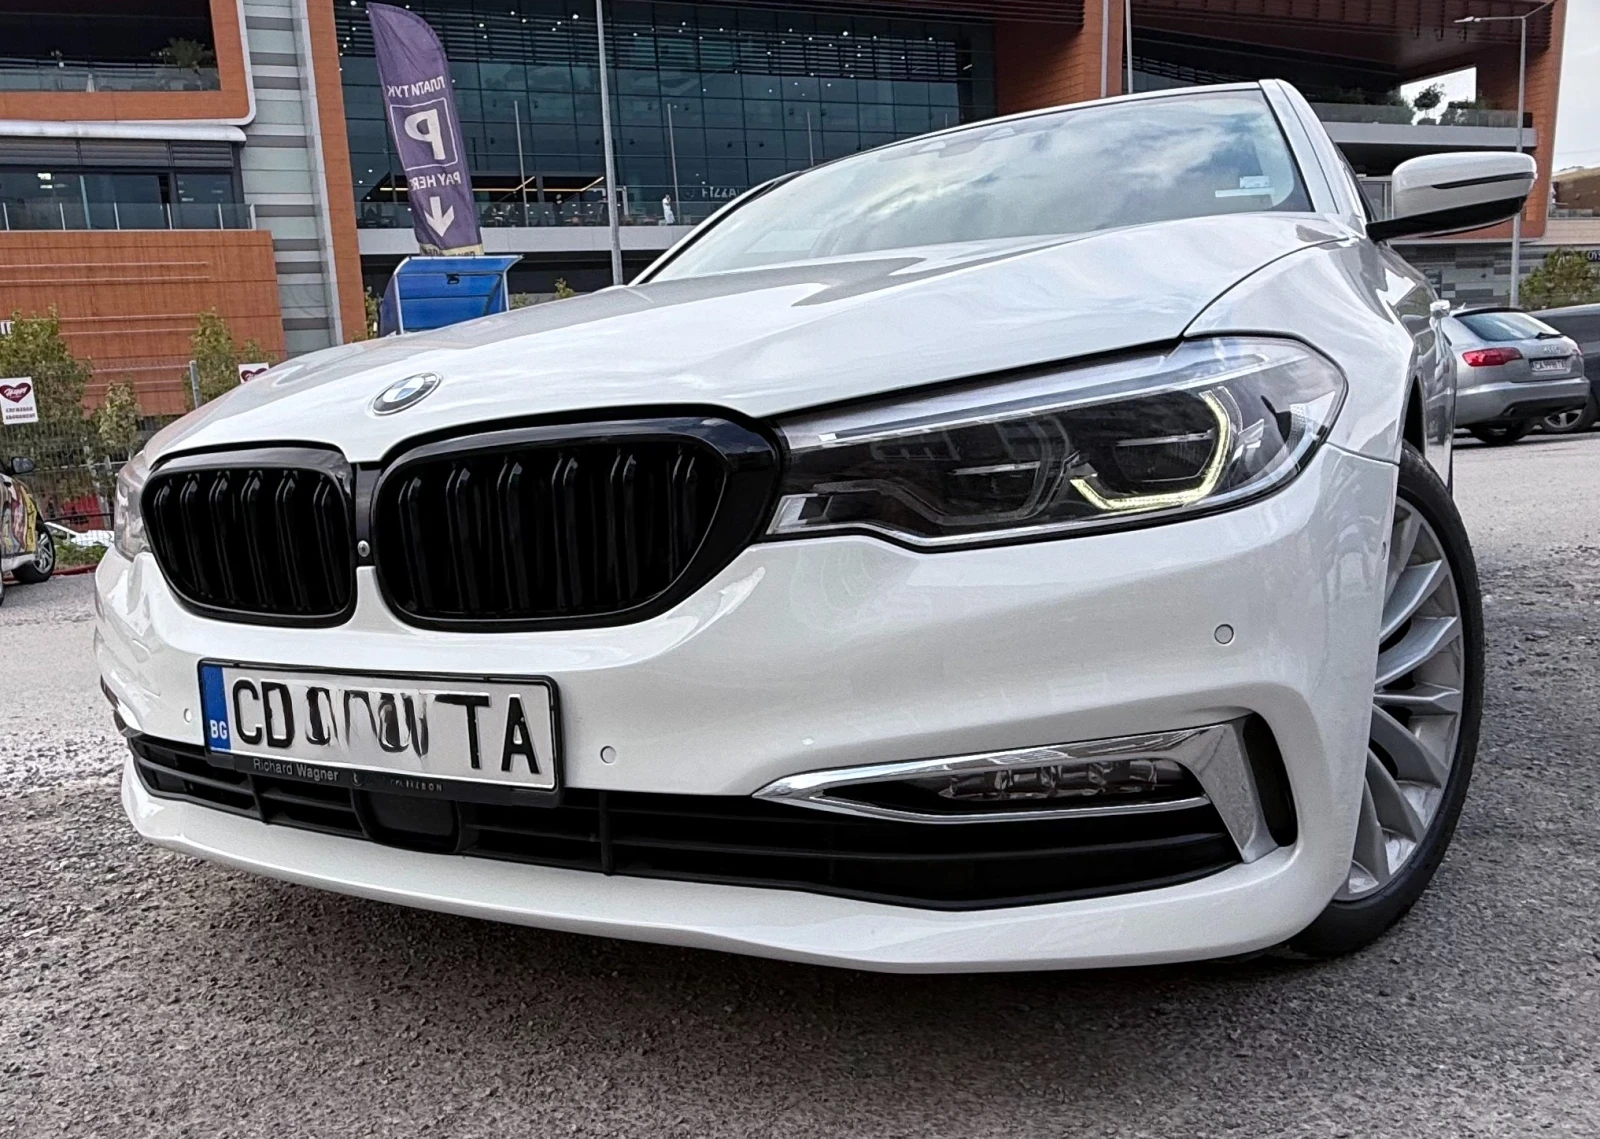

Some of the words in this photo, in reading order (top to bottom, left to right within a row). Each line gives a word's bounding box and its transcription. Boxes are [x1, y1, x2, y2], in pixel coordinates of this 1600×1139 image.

[209, 719, 229, 740] BG
[253, 757, 294, 776] Richard
[296, 763, 339, 783] Wagner
